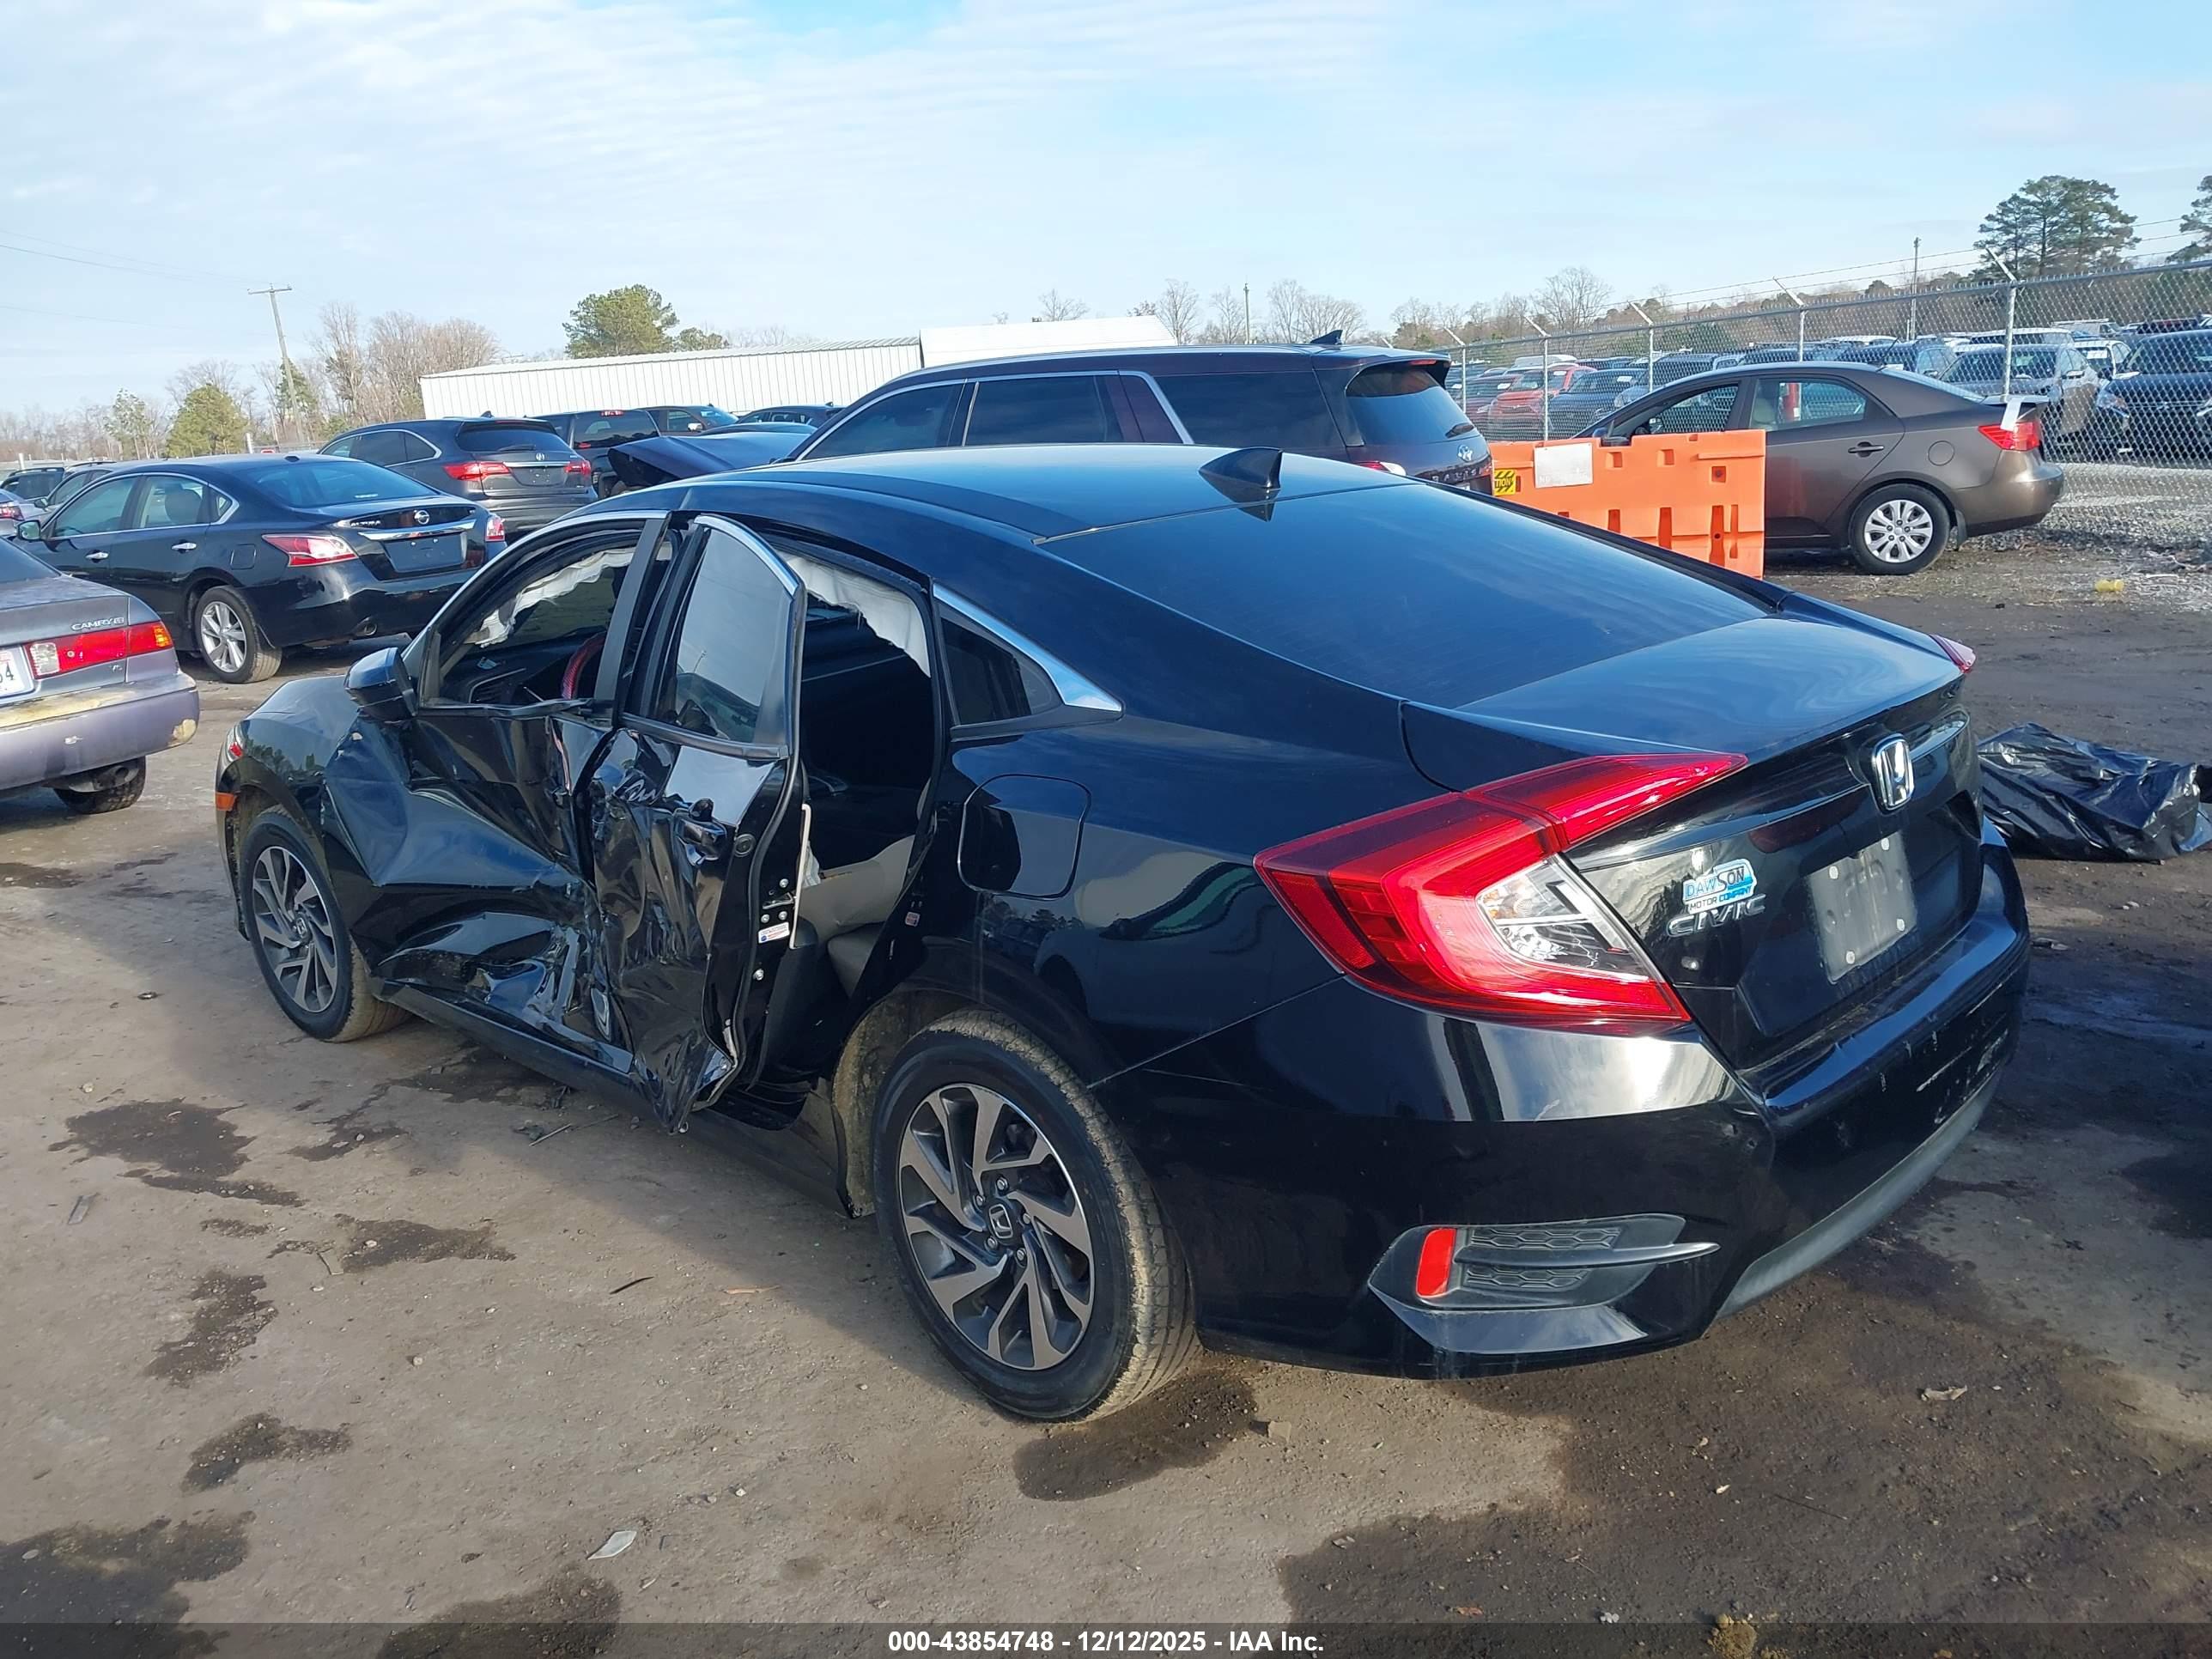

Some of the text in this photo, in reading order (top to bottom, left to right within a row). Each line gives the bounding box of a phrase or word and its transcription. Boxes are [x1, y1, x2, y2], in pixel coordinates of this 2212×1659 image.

[71, 617, 113, 631] CAMRY
[1685, 866, 1745, 898] DAWSON
[1690, 896, 1717, 911] MOTOR
[1667, 893, 1766, 938] CIVIC
